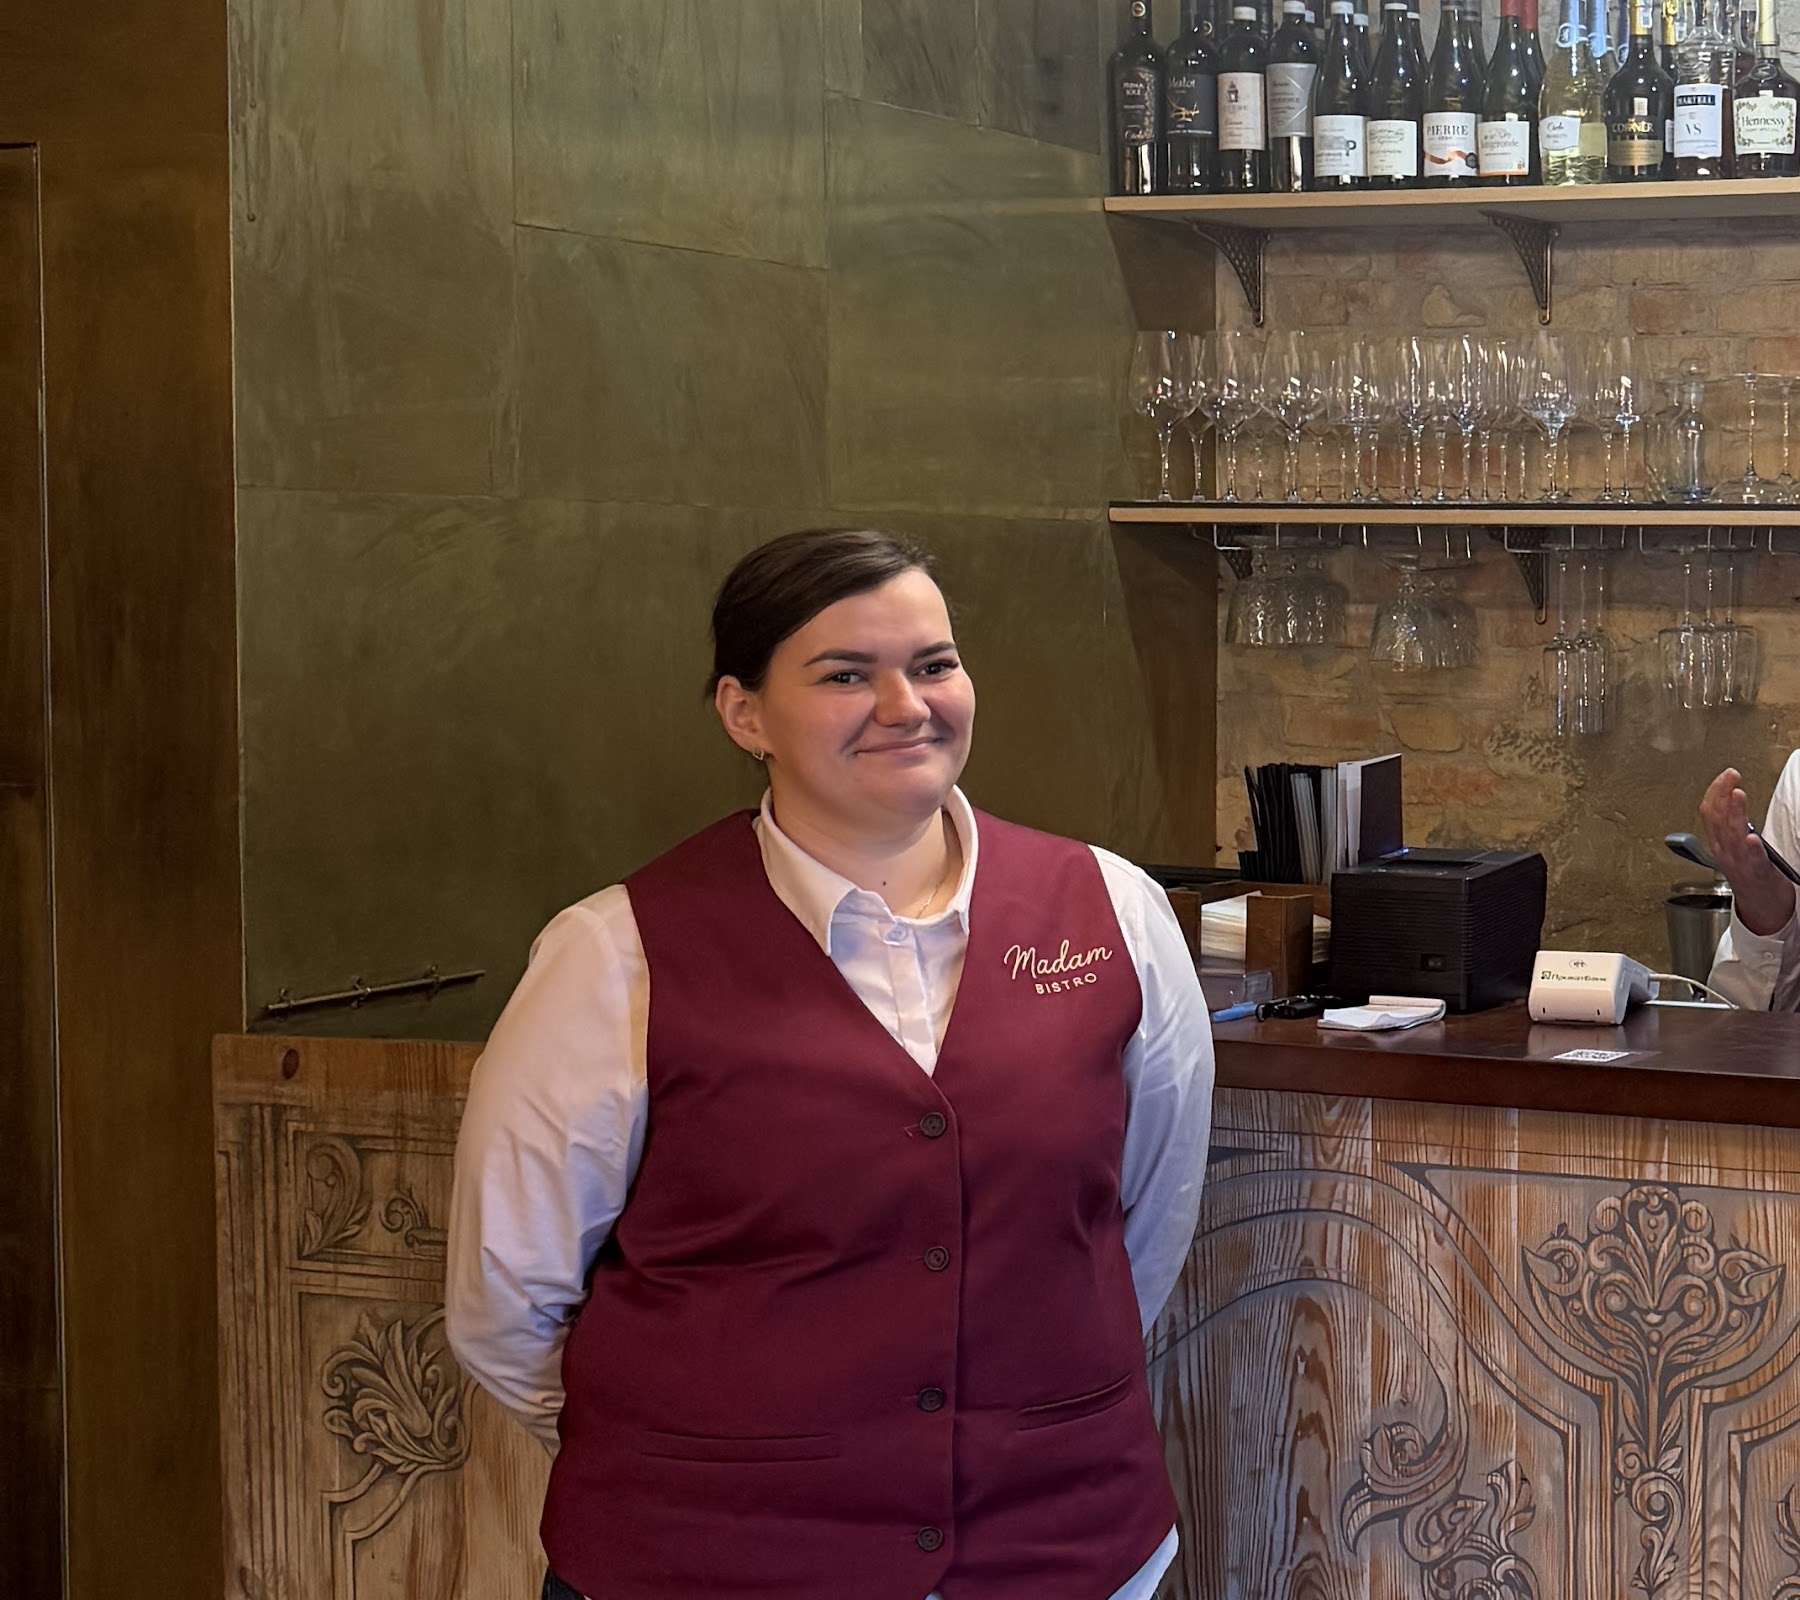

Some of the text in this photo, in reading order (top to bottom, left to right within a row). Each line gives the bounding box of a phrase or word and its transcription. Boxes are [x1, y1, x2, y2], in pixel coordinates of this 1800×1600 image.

[1741, 115, 1786, 128] Hennessy
[1426, 124, 1469, 137] PIERRE
[1686, 122, 1702, 135] VS
[1003, 938, 1113, 980] Madam
[1034, 972, 1098, 995] BISTRO
